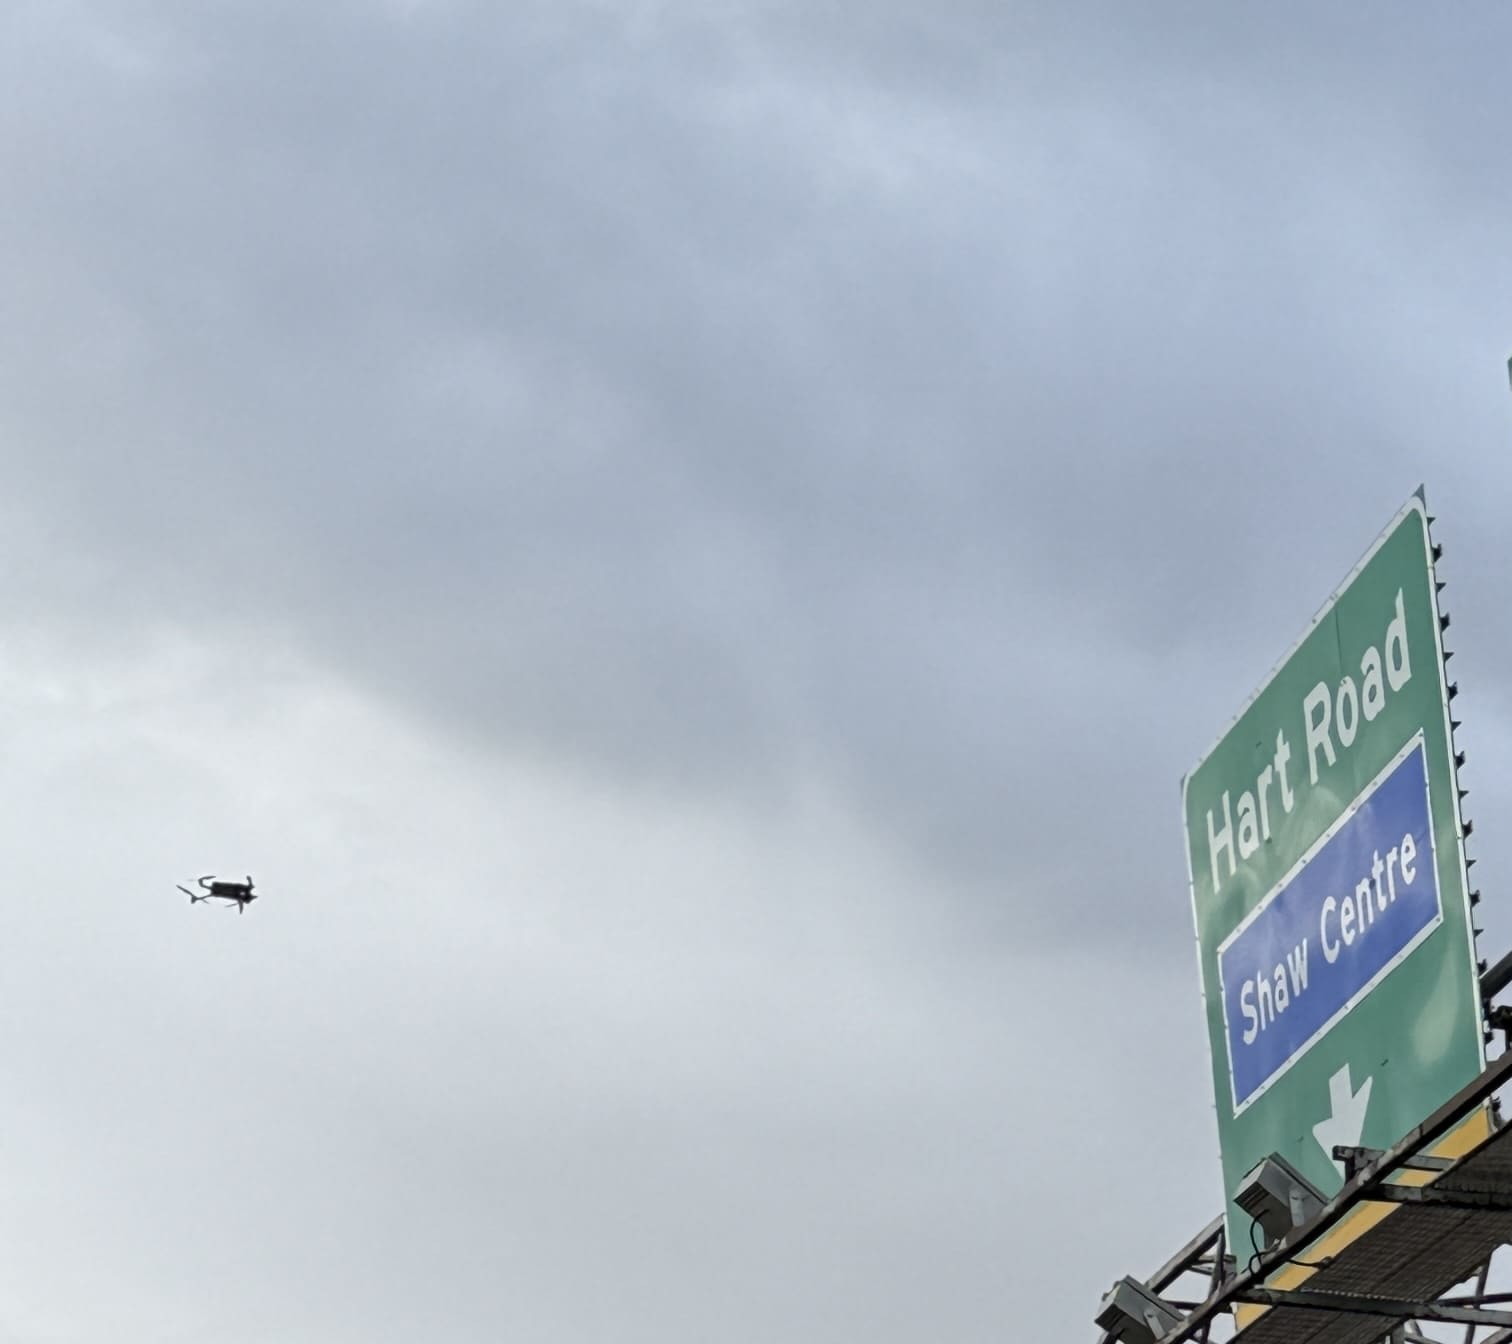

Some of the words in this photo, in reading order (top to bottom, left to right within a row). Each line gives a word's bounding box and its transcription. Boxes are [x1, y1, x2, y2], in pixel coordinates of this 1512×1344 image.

[1206, 728, 1295, 895] Hart
[1303, 586, 1413, 786] Road
[1240, 938, 1309, 1045] Shaw
[1320, 833, 1417, 964] Centre
